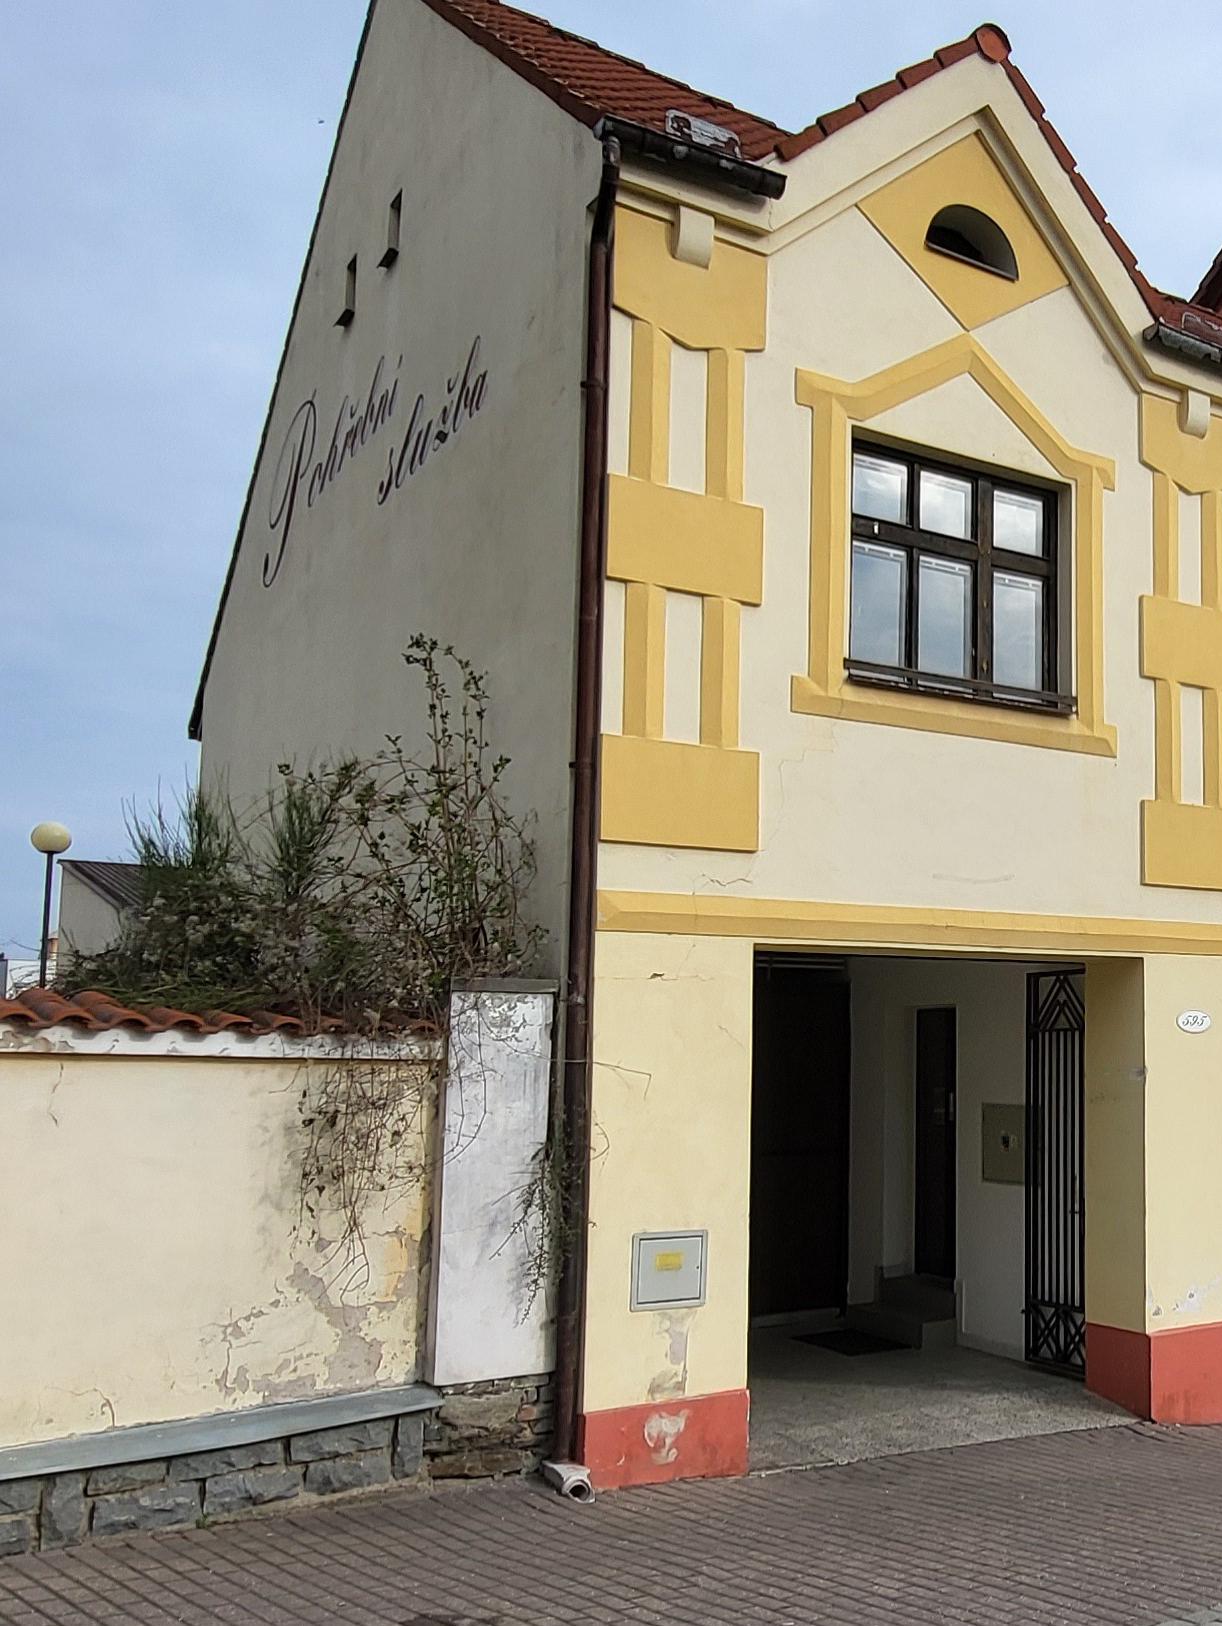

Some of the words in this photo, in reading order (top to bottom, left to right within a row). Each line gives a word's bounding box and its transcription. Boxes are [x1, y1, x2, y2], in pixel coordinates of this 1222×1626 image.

[263, 354, 404, 588] Pohřební
[377, 335, 488, 506] služba
[1182, 1014, 1208, 1027] 595
